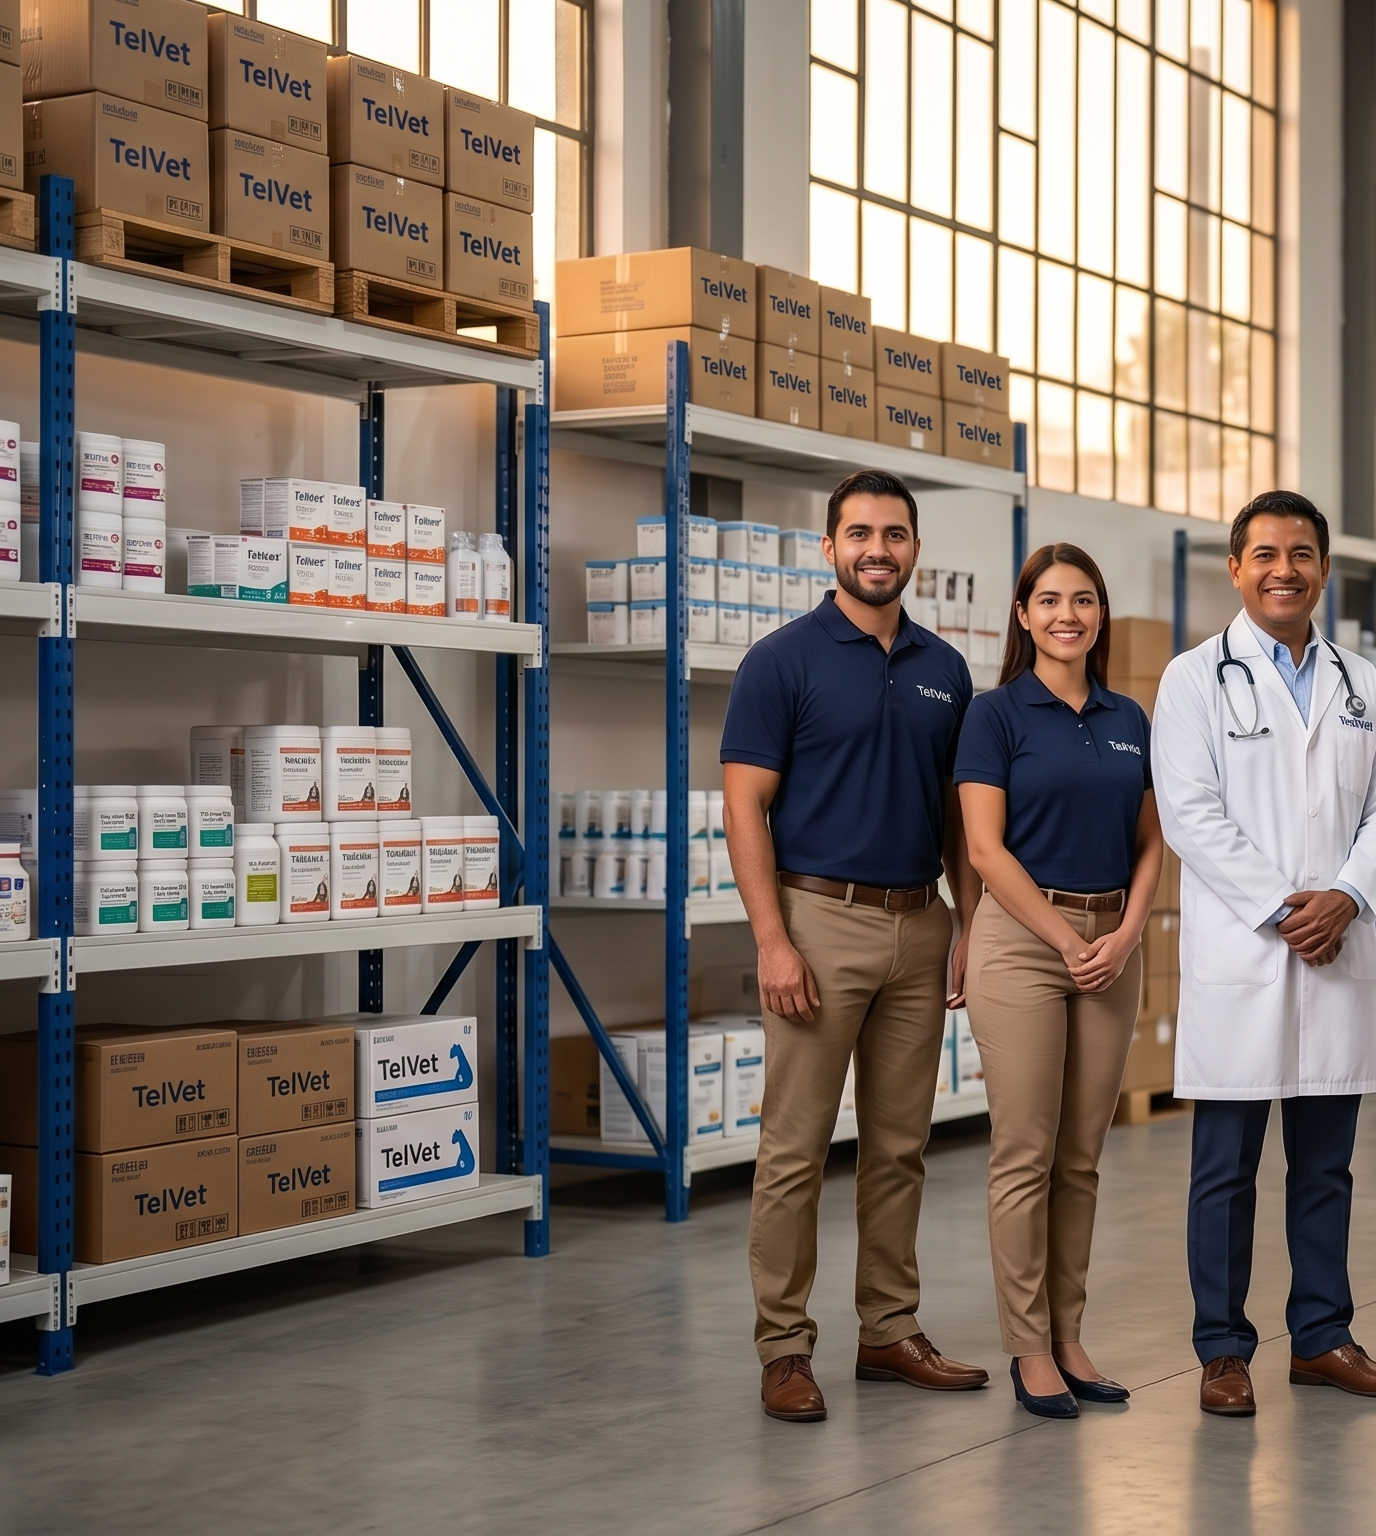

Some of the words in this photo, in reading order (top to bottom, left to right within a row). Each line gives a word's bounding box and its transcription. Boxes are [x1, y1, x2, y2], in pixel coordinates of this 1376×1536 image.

[110, 20, 190, 65] TelVet
[240, 59, 311, 101] TelVet
[363, 98, 428, 136] TelVet
[110, 138, 190, 180] TelVet
[461, 128, 520, 165] TelVet
[240, 173, 312, 212] TelVet
[362, 206, 428, 243] TelVet
[460, 231, 520, 265] TelVet
[701, 277, 747, 303] TelVet
[770, 295, 811, 319] TelVet
[827, 311, 866, 334] TelVet
[701, 356, 747, 380] TelVet
[885, 348, 932, 374] TelVet
[770, 370, 810, 394] TelVet
[957, 365, 1001, 390] TelVet
[828, 385, 867, 408] TelVet
[886, 406, 932, 431] TelVet
[957, 422, 1001, 446] TelVet
[378, 1054, 439, 1081] TelVet
[132, 1080, 205, 1107] TelVet
[267, 1071, 329, 1097] TelVet
[381, 1141, 441, 1169] TelVet
[267, 1165, 330, 1194] TelVet
[135, 1185, 207, 1215] TelVet
